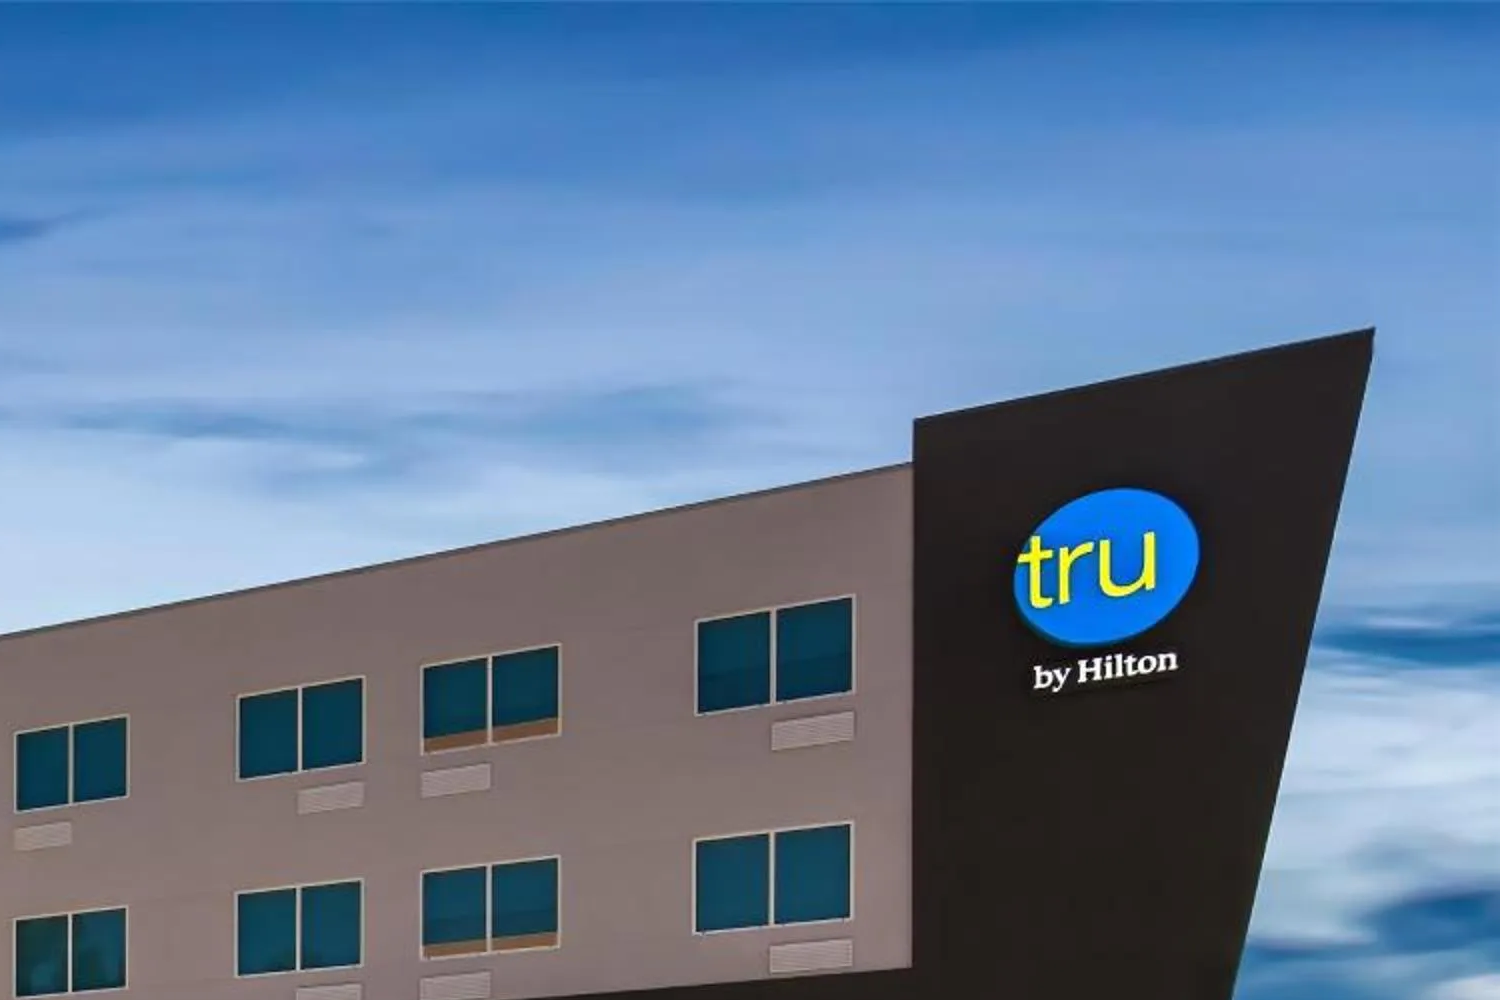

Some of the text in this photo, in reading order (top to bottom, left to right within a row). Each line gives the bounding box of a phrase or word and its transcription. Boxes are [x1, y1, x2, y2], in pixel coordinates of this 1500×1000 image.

[1017, 531, 1156, 609] tru
[1033, 651, 1179, 693] by Hilton
